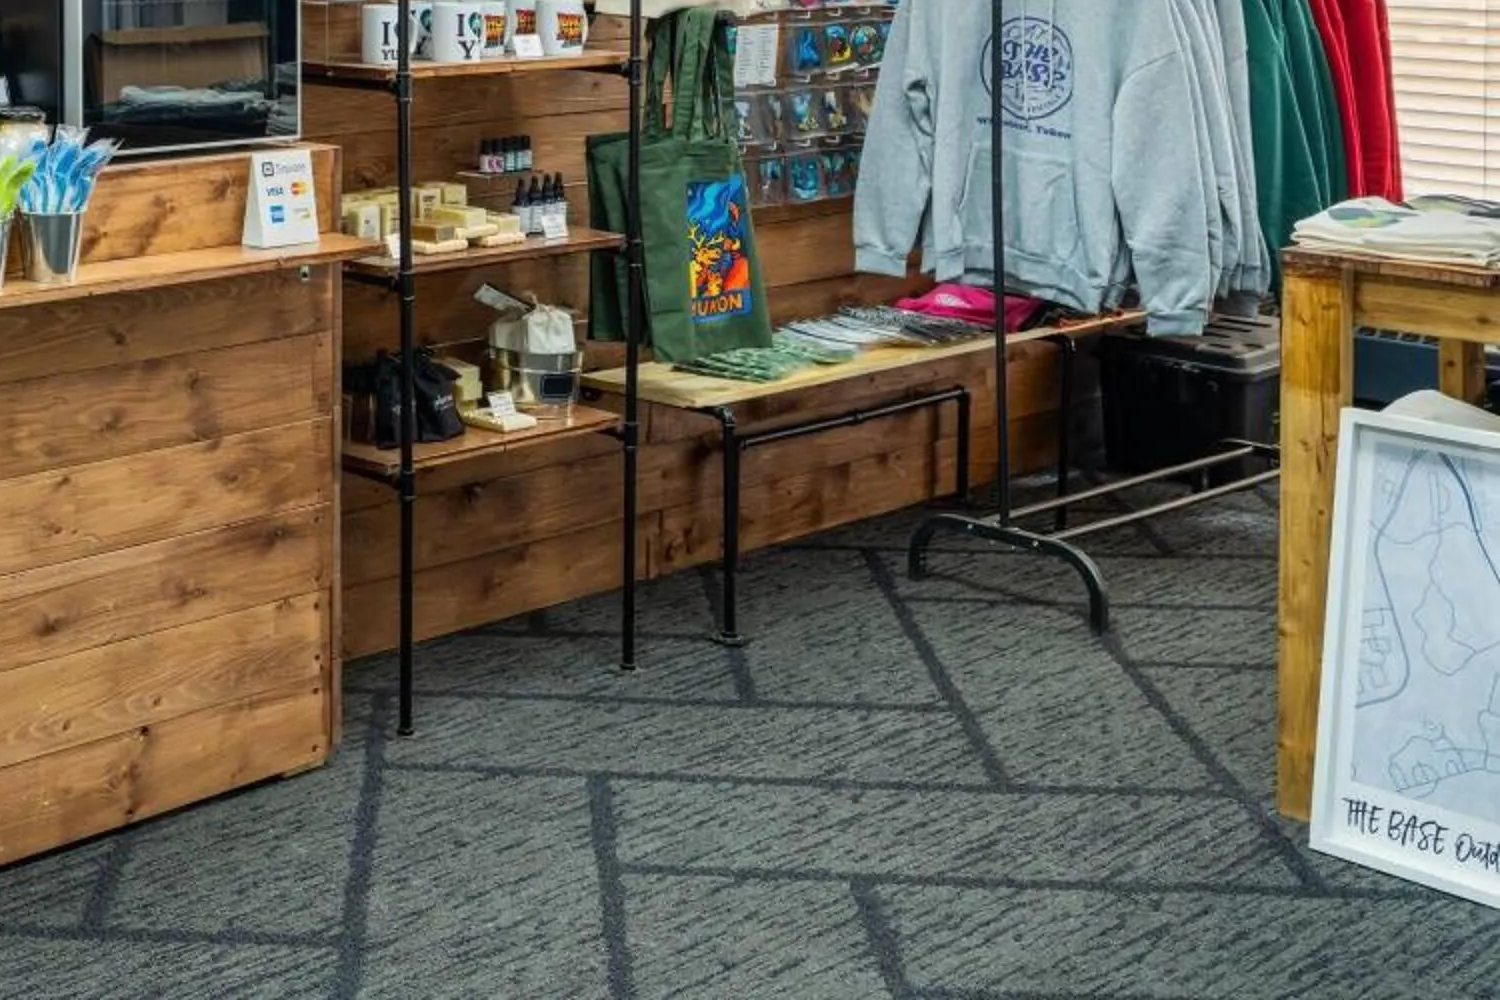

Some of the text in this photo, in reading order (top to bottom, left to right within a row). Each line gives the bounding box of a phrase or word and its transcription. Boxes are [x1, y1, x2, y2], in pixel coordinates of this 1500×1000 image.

[1003, 39, 1059, 63] THE
[266, 187, 284, 196] VISA
[1342, 797, 1385, 835] THE
[1387, 810, 1449, 855] BASE
